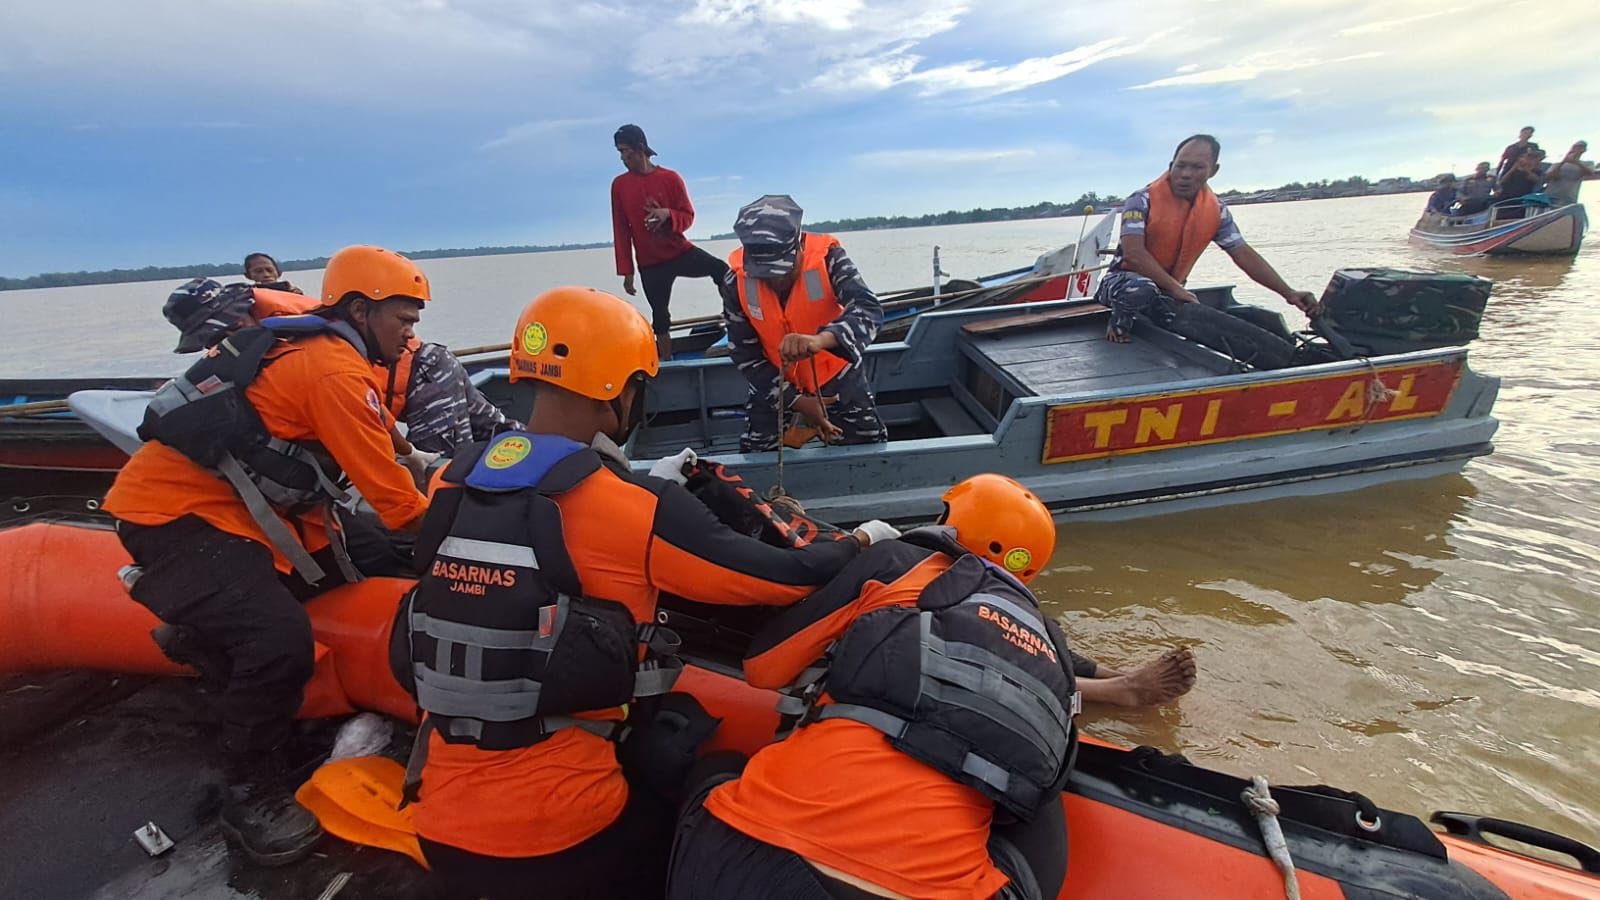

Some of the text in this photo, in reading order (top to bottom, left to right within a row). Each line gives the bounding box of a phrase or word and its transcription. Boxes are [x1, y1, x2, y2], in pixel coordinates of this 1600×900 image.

[540, 362, 562, 378] JAMBI
[1085, 400, 1222, 448] TNI
[1328, 375, 1418, 421] AL
[432, 560, 516, 587] BASARNAS
[450, 584, 486, 596] JAMBI
[978, 606, 1056, 663] BASARNAS
[1002, 632, 1037, 656] JAMBI
